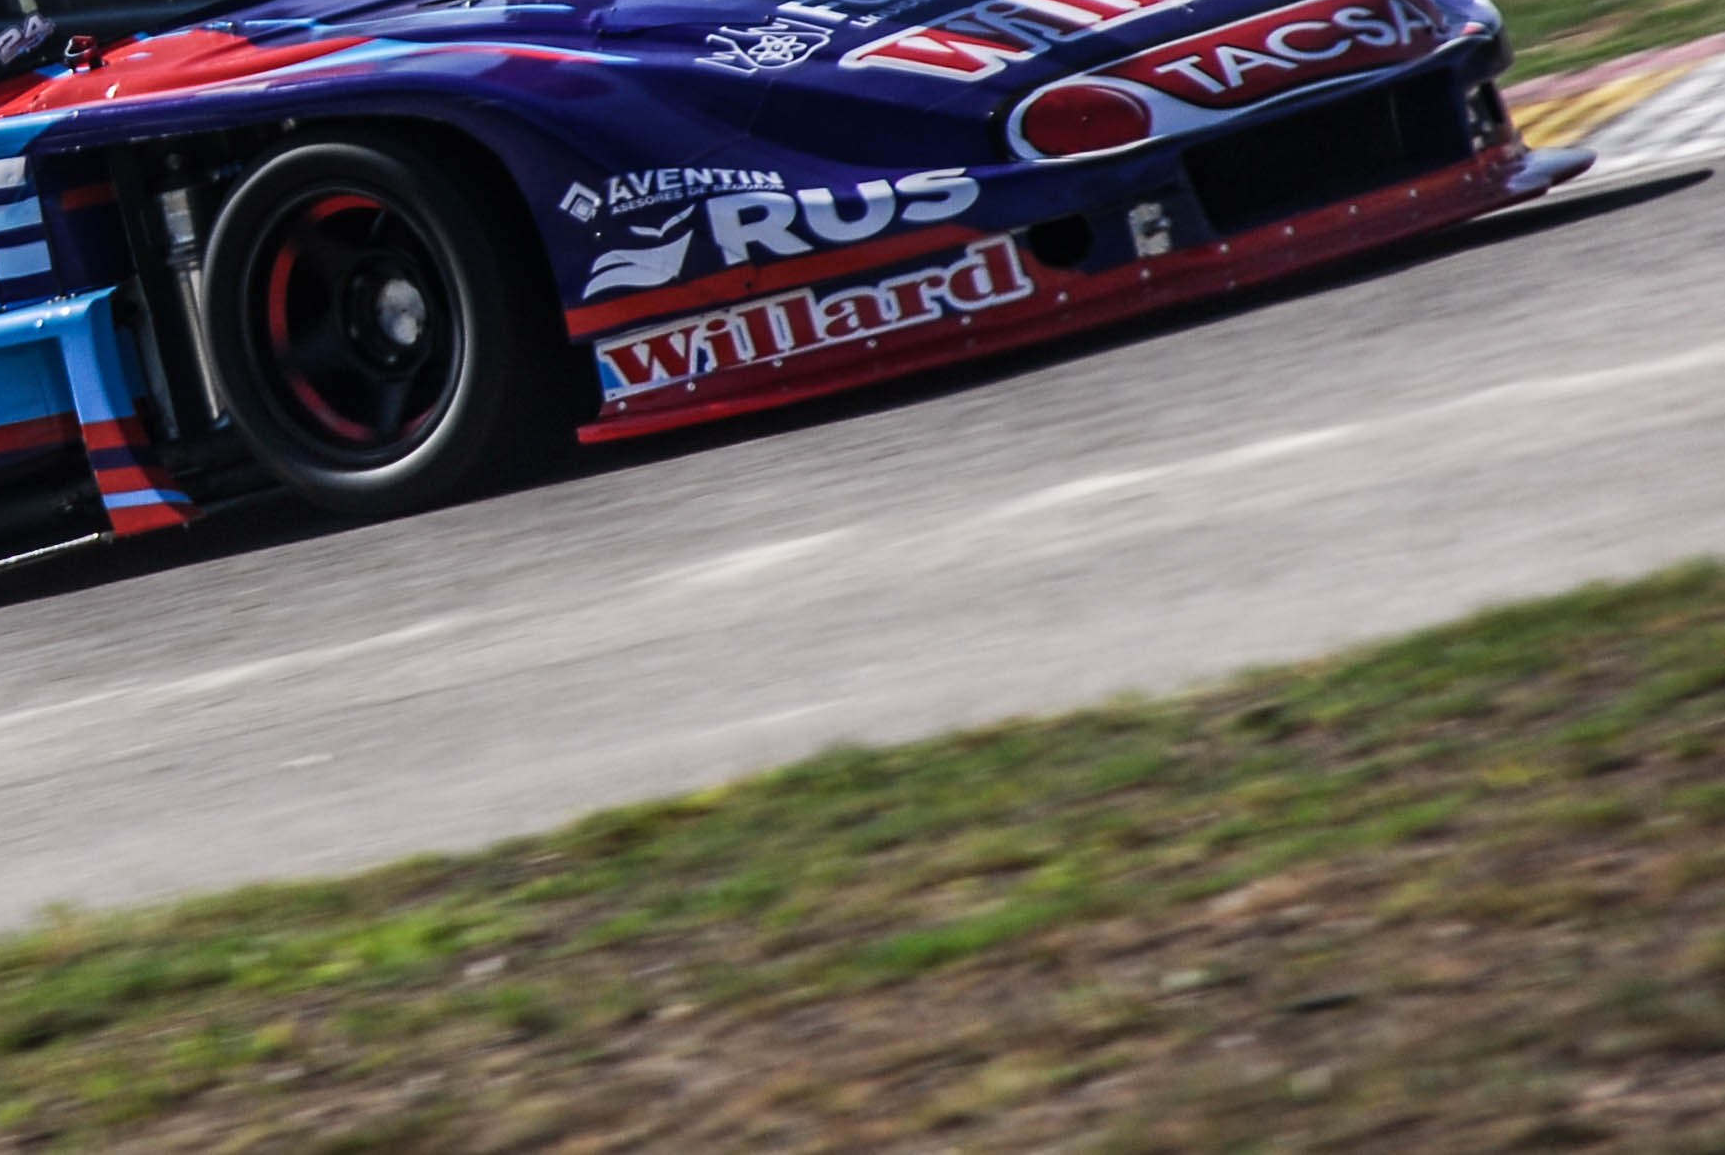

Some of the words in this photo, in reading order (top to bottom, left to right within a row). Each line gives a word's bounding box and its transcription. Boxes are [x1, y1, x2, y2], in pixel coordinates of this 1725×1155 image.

[608, 167, 784, 205] AVENTIN
[706, 167, 980, 266] RUS
[598, 237, 1033, 392] Willard
